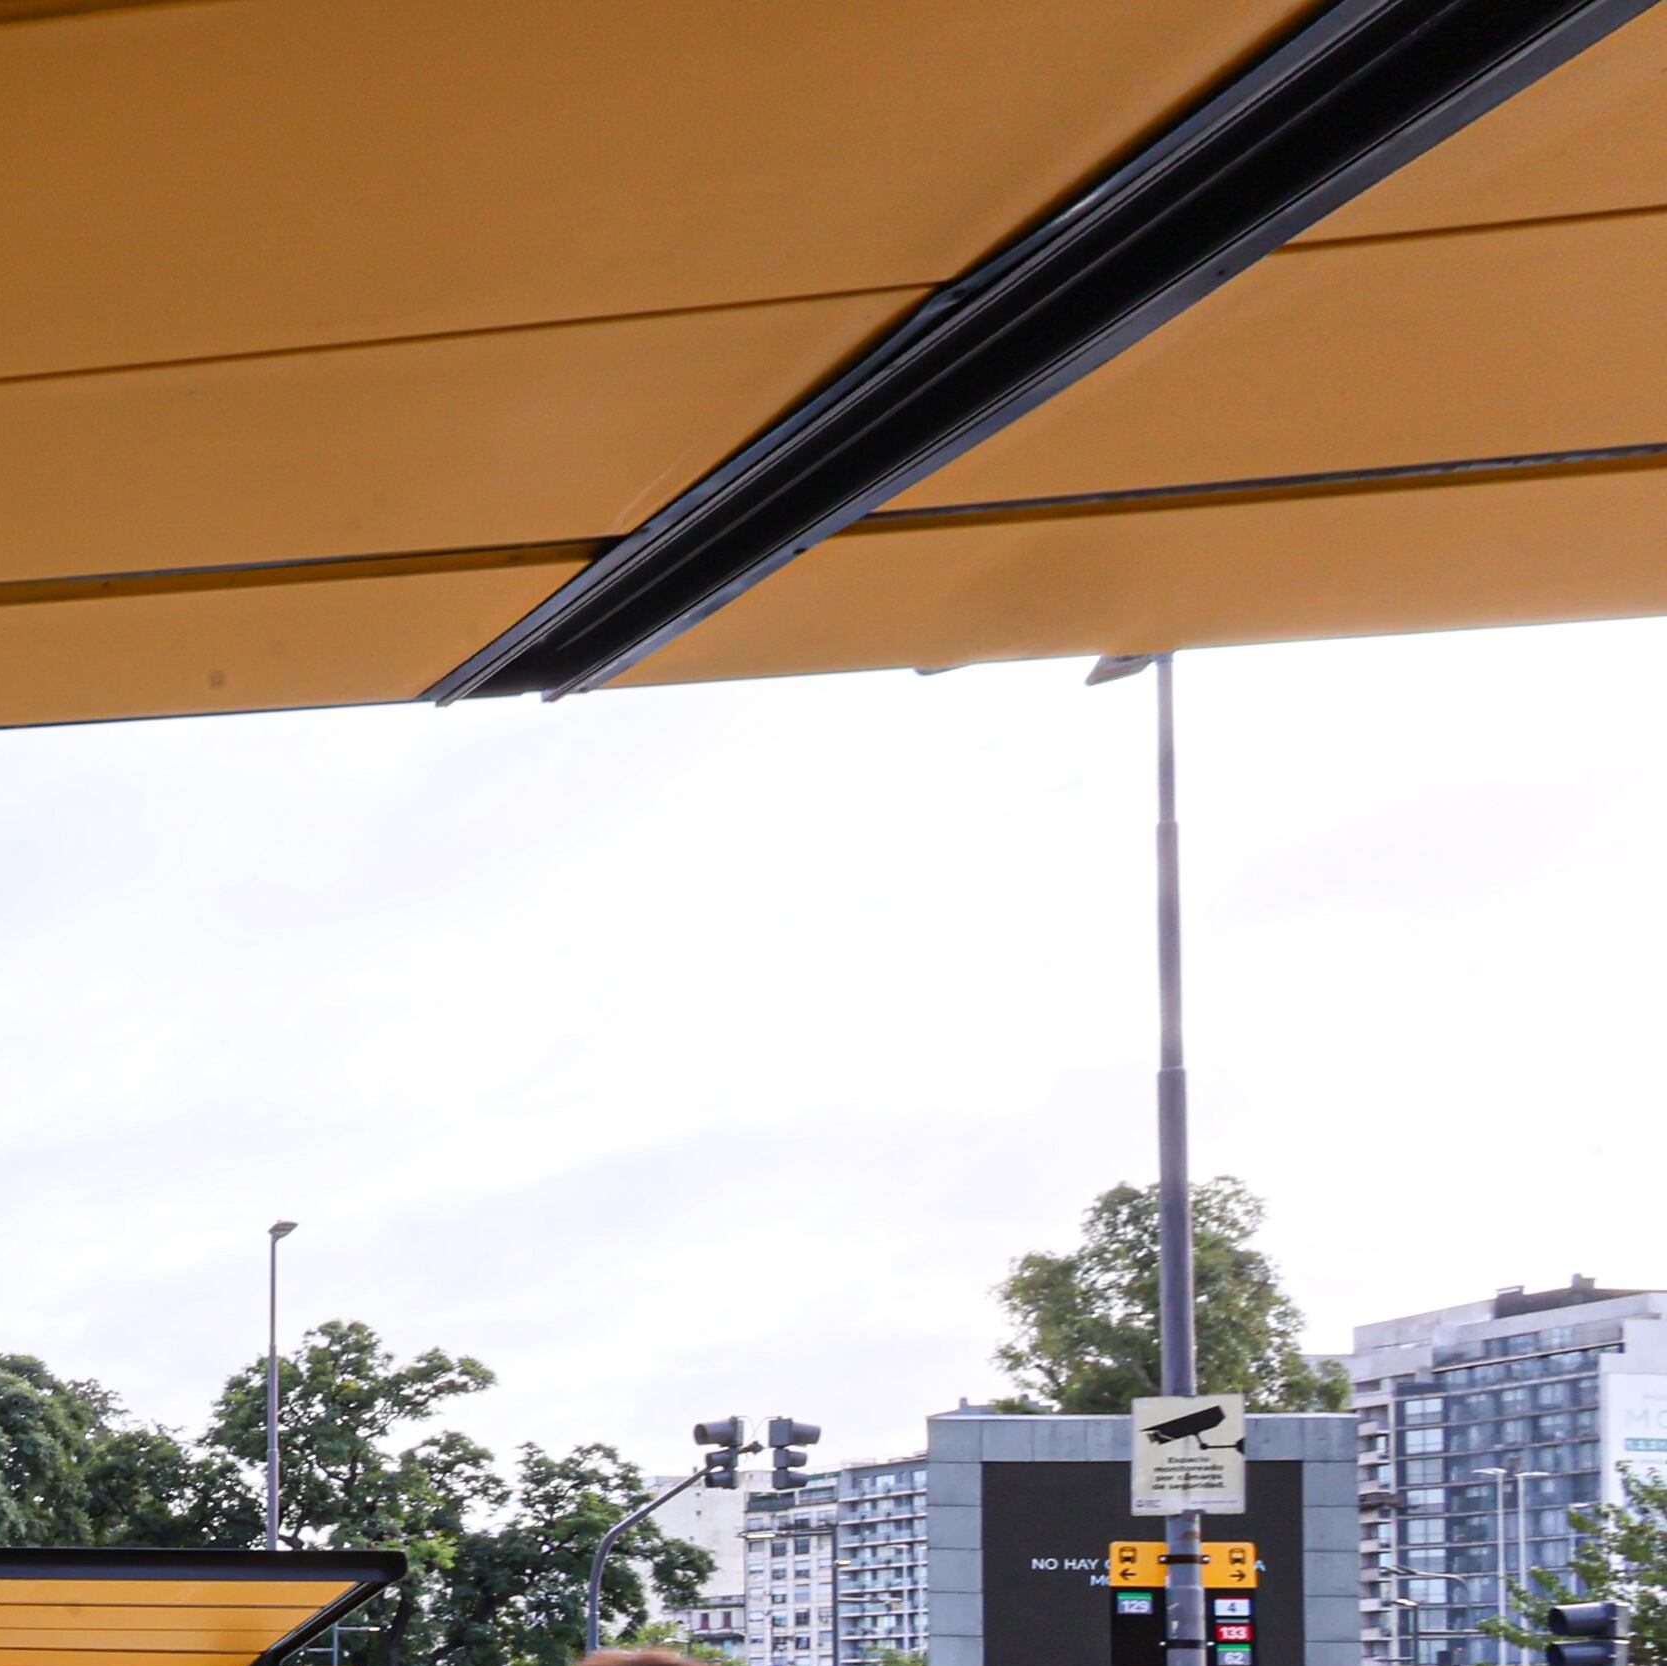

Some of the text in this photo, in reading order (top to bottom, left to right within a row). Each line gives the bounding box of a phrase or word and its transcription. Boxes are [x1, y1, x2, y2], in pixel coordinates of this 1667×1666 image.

[1031, 1558, 1059, 1570] NO
[1064, 1558, 1099, 1570] HAY
[1121, 1600, 1150, 1613] 129
[1228, 1602, 1238, 1613] 4
[1219, 1626, 1248, 1640] 133
[1224, 1652, 1245, 1665] 62
